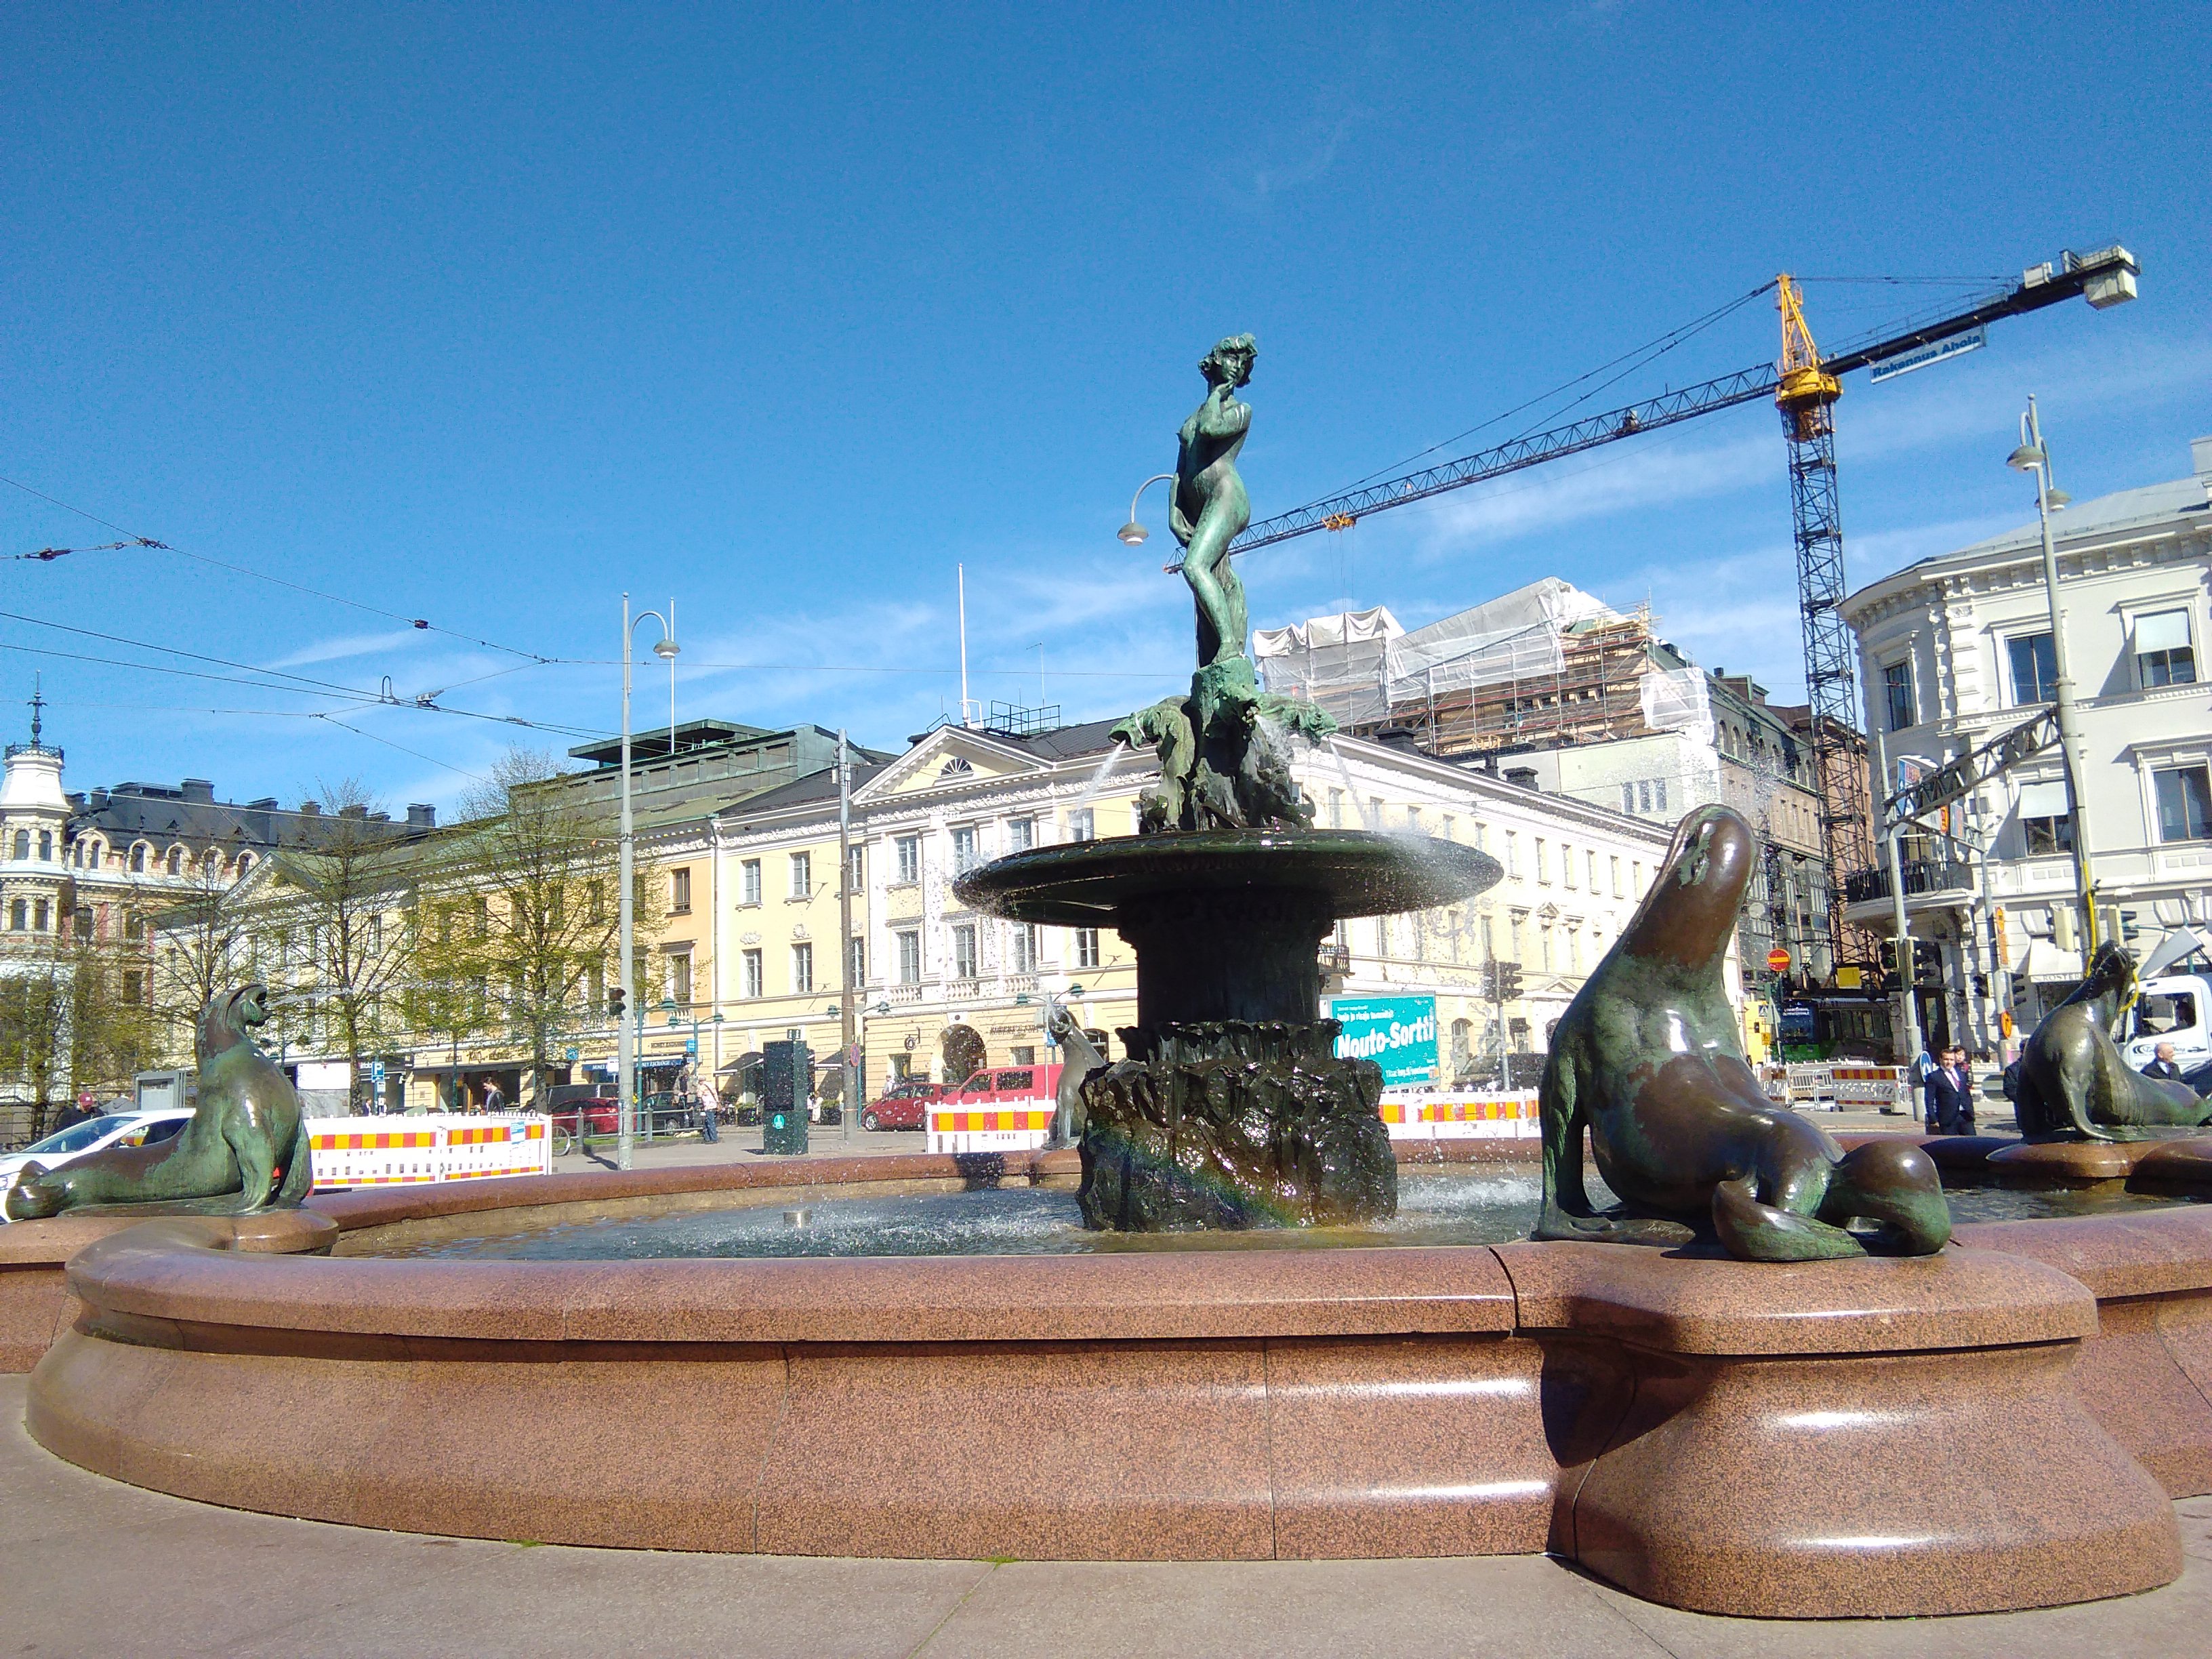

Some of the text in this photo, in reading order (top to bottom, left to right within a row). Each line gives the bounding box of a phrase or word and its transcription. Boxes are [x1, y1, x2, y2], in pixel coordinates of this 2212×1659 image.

[1872, 335, 1980, 377] Rakennus Ahola
[1337, 1015, 1434, 1059] Nouto-Sortti
[374, 1063, 382, 1075] P
